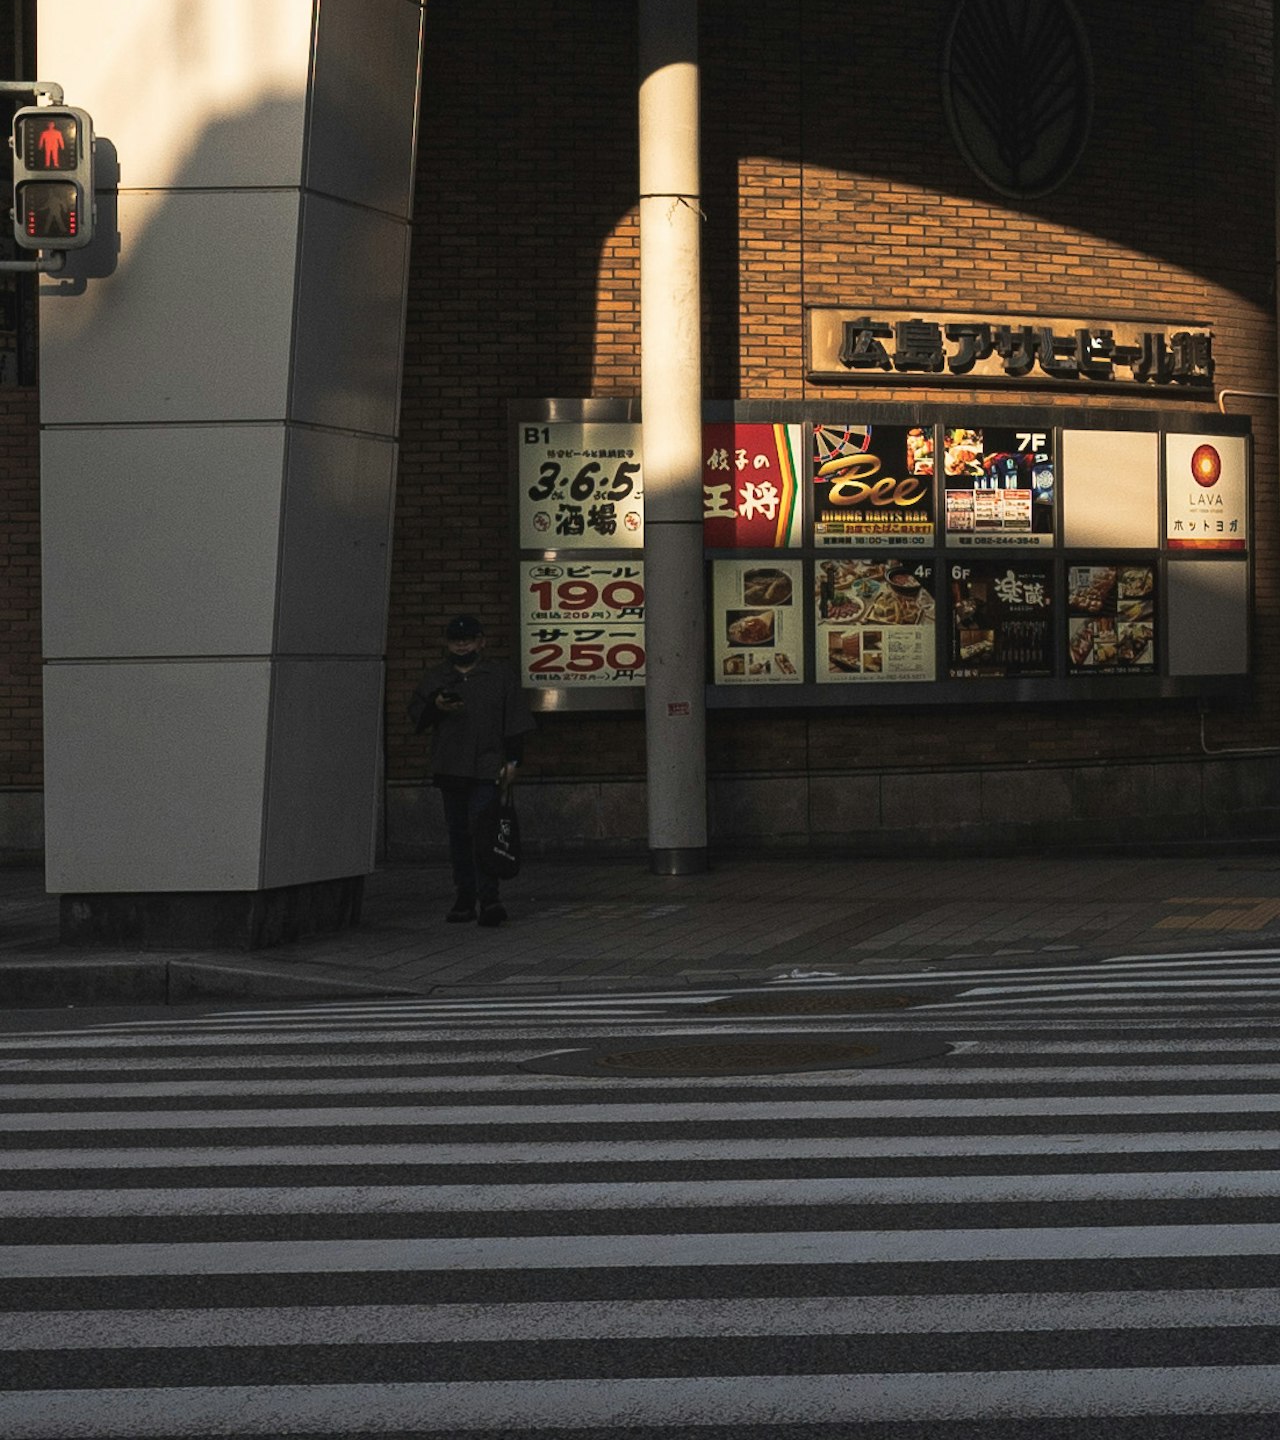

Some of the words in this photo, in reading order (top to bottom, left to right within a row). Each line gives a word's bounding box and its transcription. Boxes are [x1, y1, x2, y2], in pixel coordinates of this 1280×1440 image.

[839, 316, 1215, 386] 広島アサヒビール館
[524, 427, 551, 444] B1
[1015, 432, 1047, 452] 7F
[706, 448, 771, 471] 餃子の
[817, 453, 928, 507] Bee
[703, 480, 781, 520] 王将
[1189, 493, 1224, 506] LAVA
[555, 502, 618, 536] 酒場
[865, 509, 903, 522] DARTS
[905, 509, 928, 522] BAR
[1173, 519, 1239, 533] ホットヨガ
[914, 564, 932, 577] 4F
[951, 565, 971, 580] 6F
[529, 580, 645, 611] 190
[993, 569, 1046, 608] 楽蔵
[530, 629, 637, 643] サワー
[528, 643, 645, 673] 250
